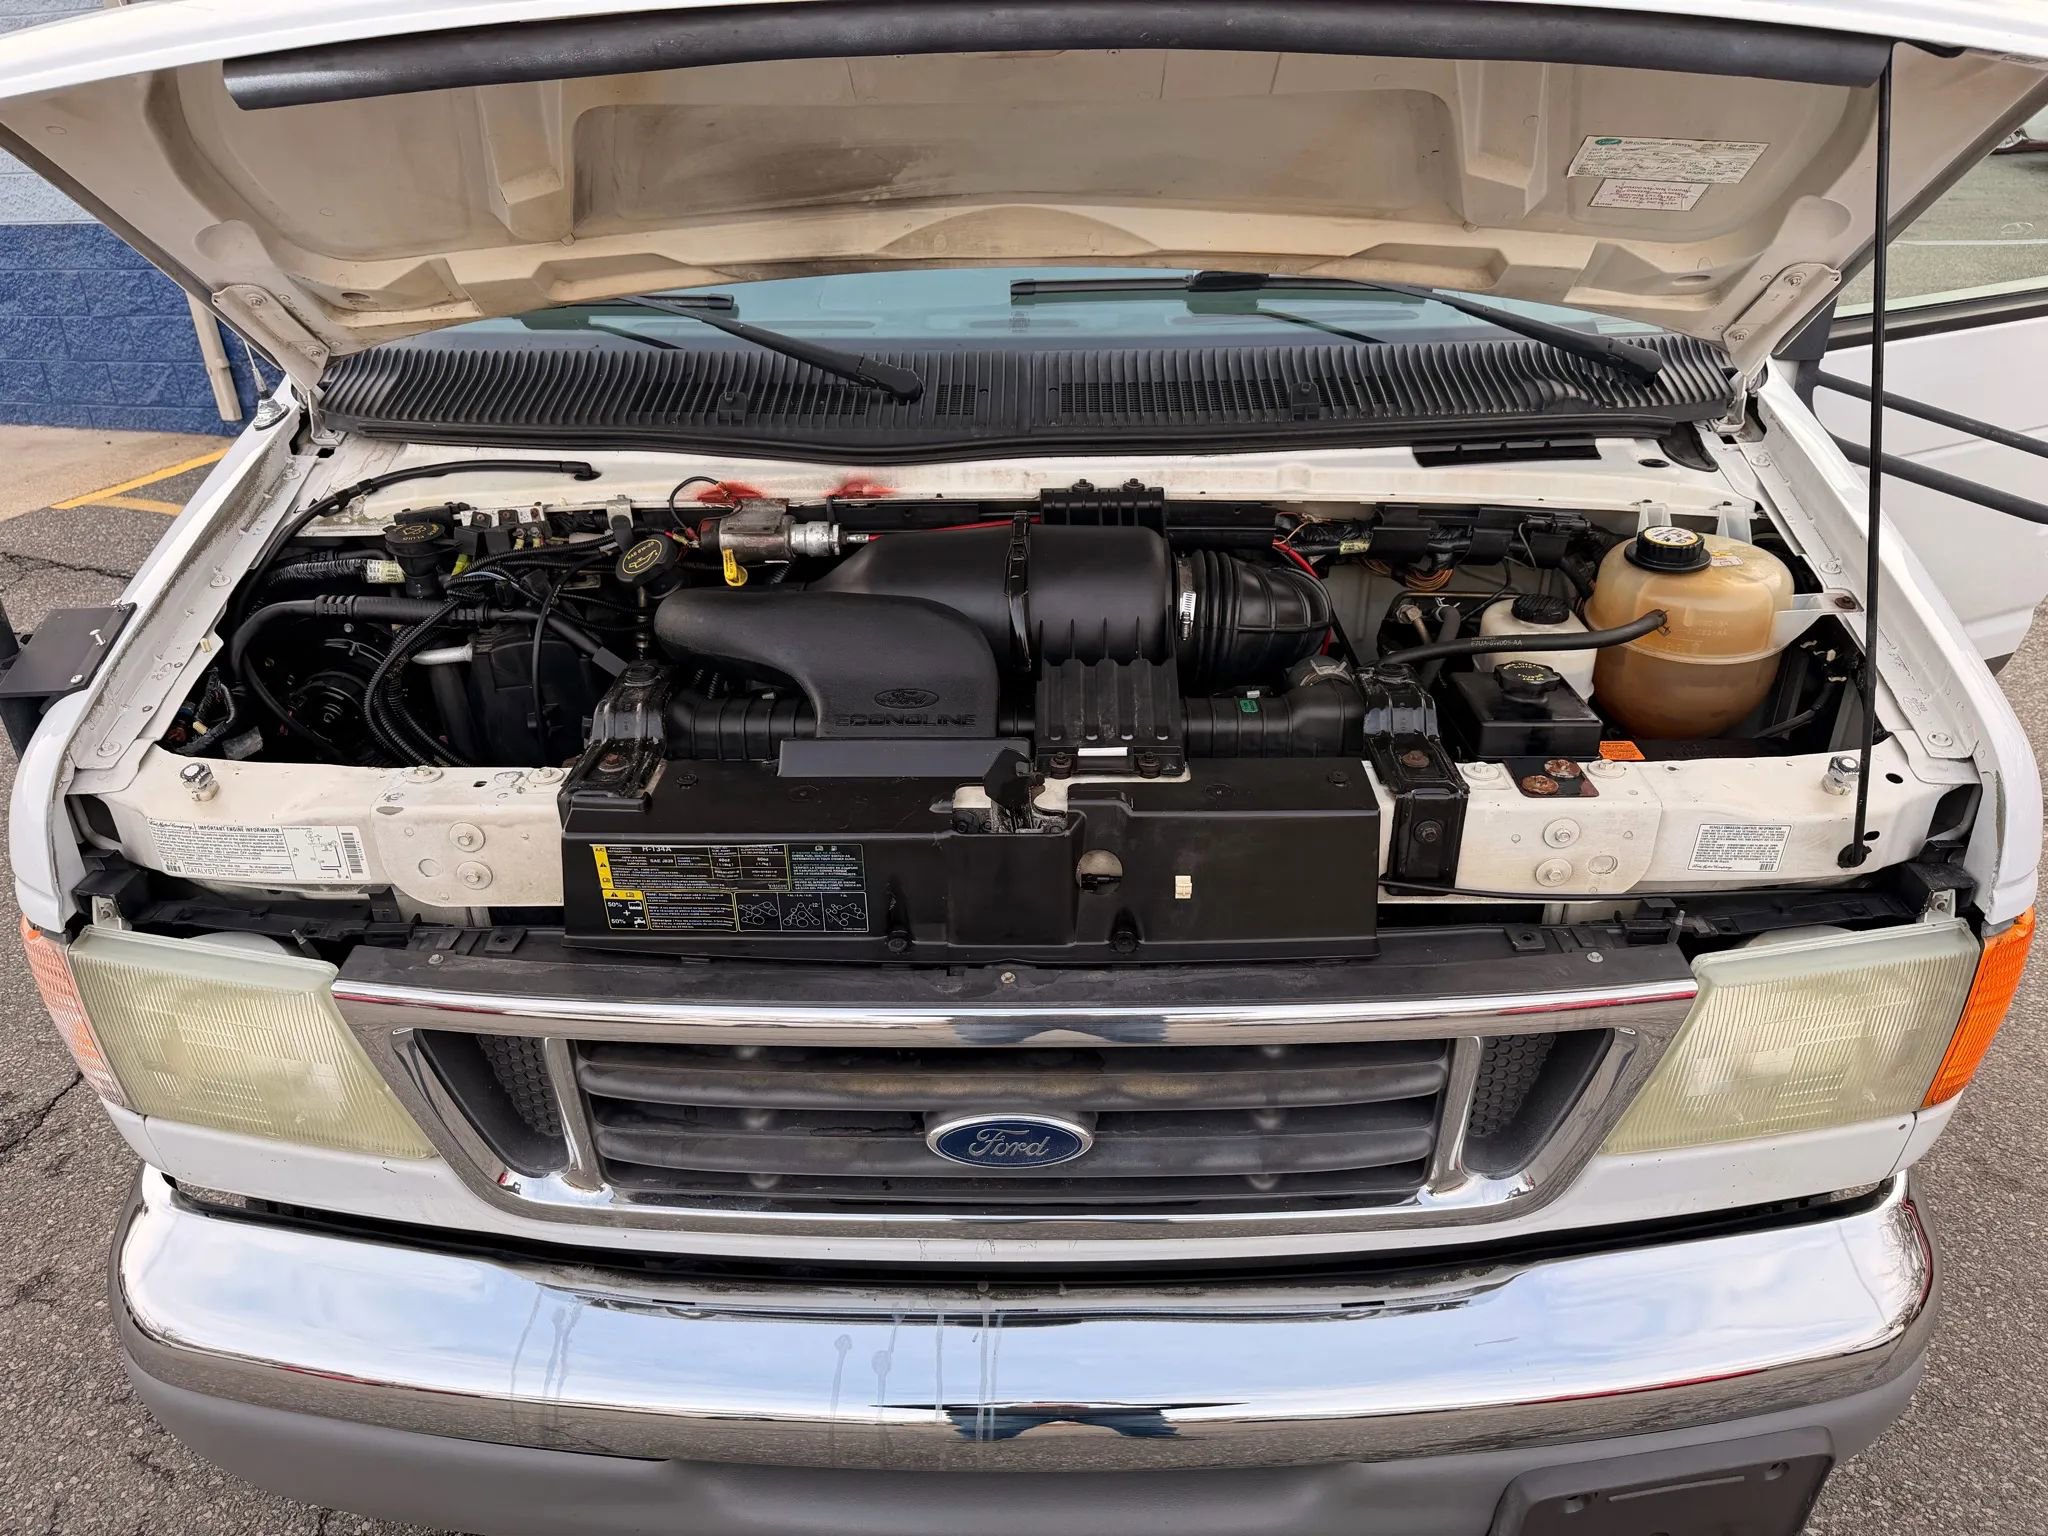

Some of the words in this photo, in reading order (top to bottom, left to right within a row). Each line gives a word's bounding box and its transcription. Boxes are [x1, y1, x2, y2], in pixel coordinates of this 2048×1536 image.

[834, 713, 977, 728] ECONOLINE
[186, 867, 215, 875] CATALYST
[967, 1128, 1051, 1158] Ford
